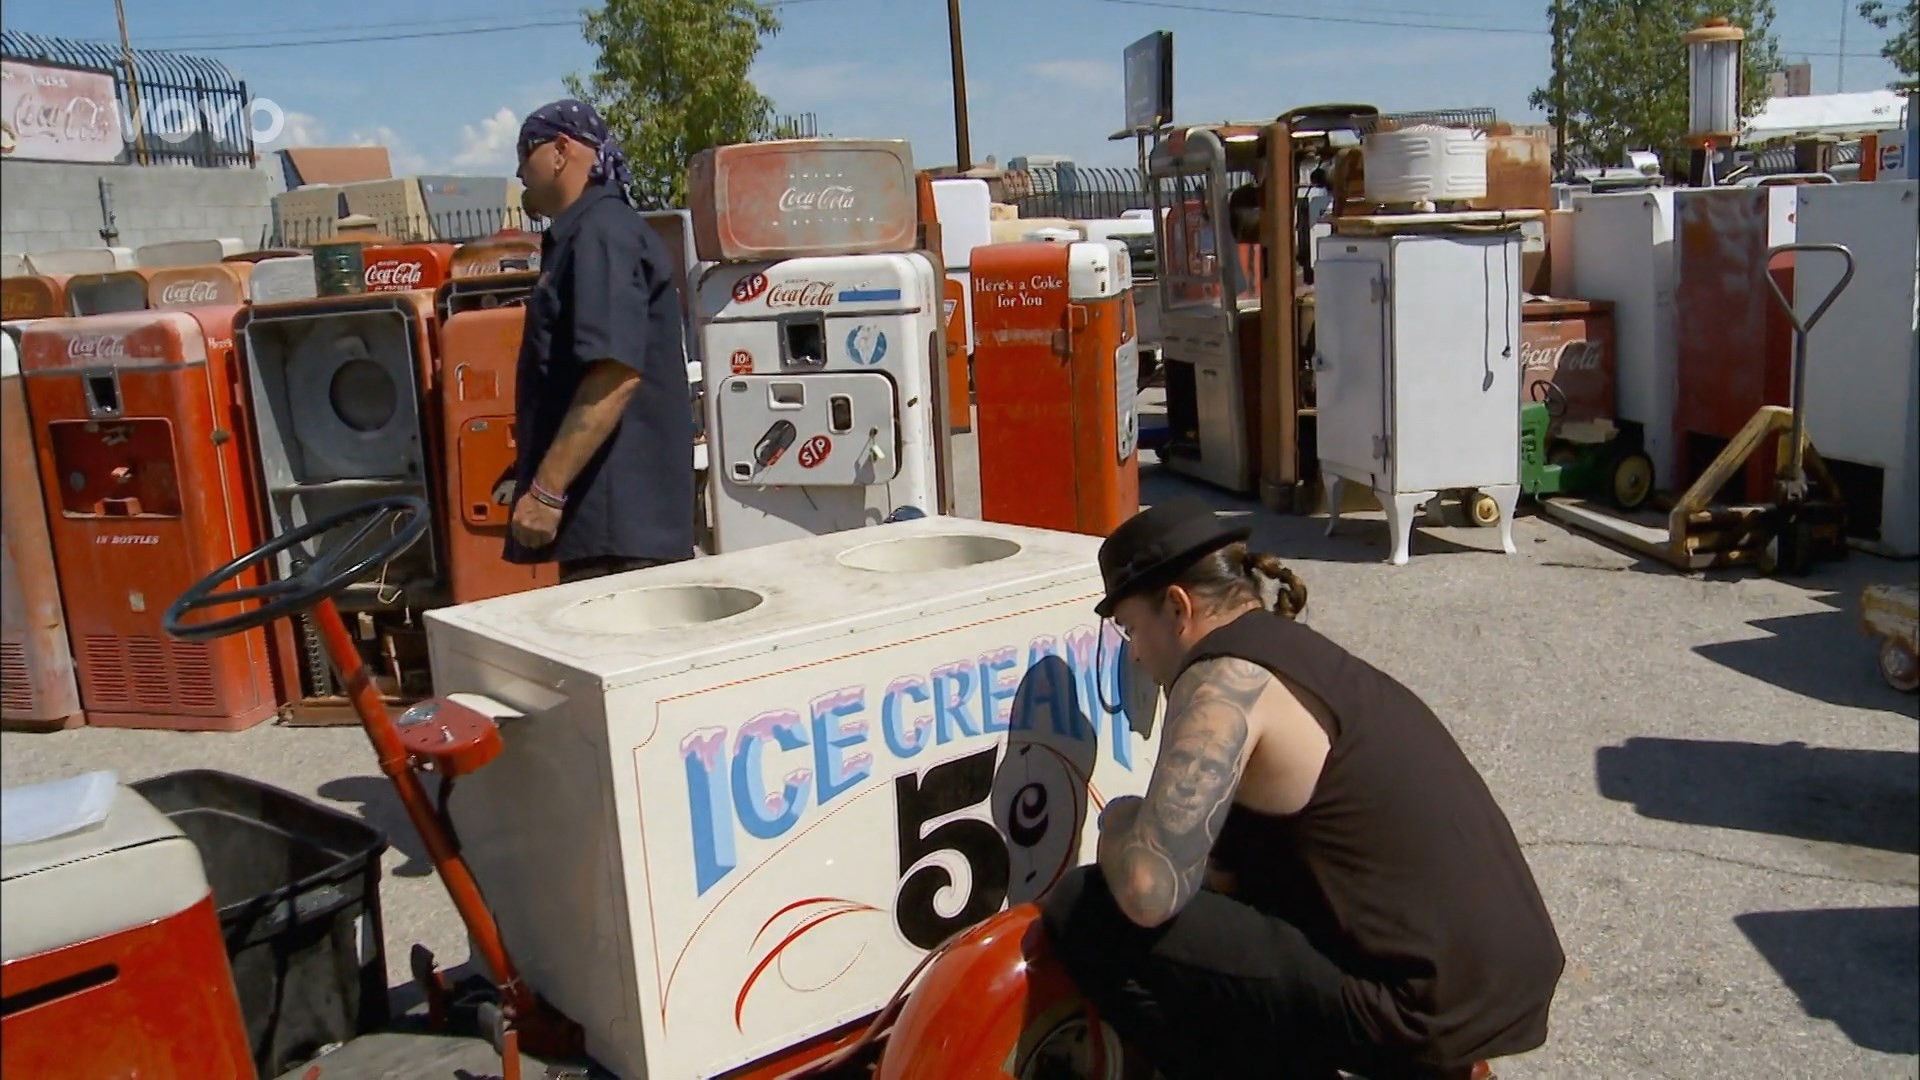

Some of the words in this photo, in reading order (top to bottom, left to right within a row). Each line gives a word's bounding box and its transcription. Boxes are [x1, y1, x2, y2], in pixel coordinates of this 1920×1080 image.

[735, 274, 763, 300] STP
[975, 278, 1014, 292] Here's
[1019, 281, 1026, 290] a
[1031, 275, 1062, 290] Coke
[998, 293, 1017, 308] for
[1019, 292, 1042, 306] You
[801, 438, 826, 466] STP
[112, 535, 160, 545] BOTTLES
[680, 684, 873, 898] ICE
[881, 616, 1133, 772] CREAM
